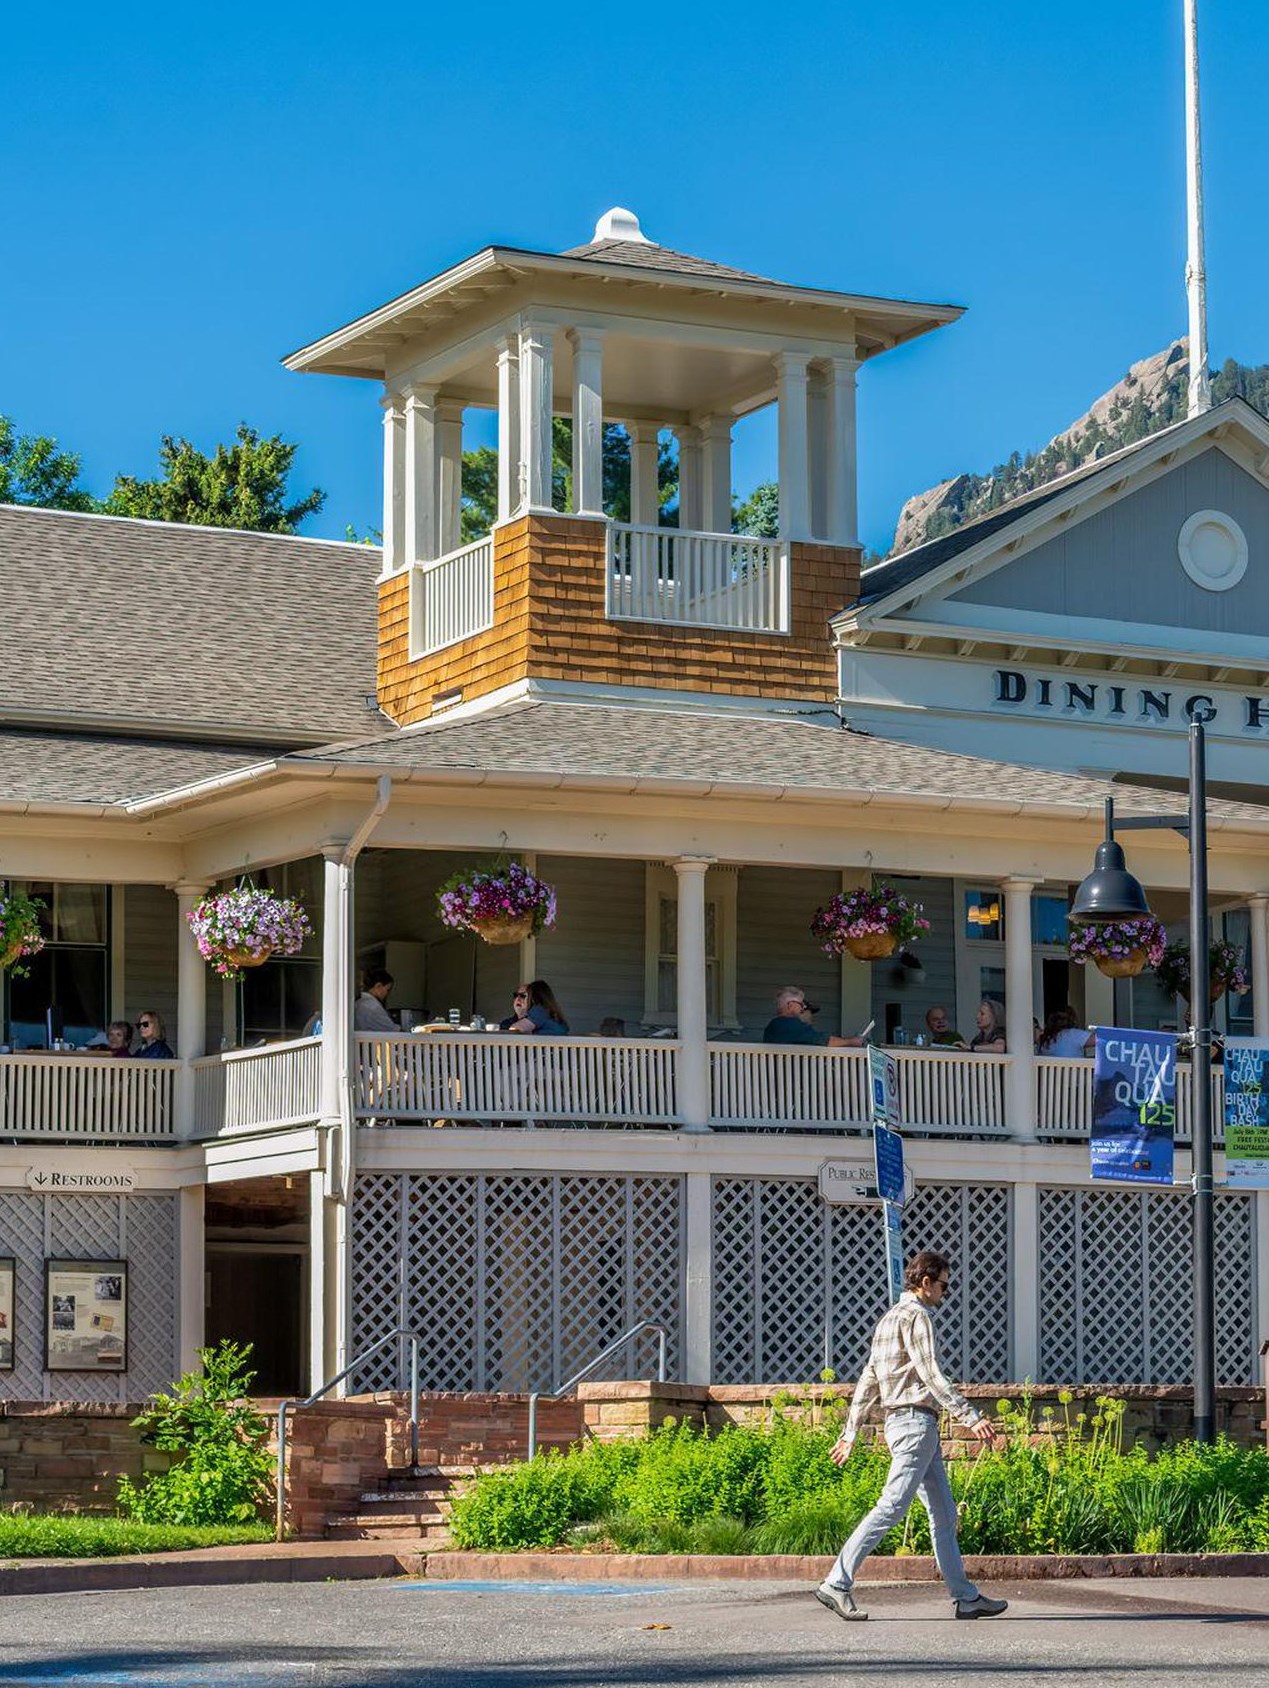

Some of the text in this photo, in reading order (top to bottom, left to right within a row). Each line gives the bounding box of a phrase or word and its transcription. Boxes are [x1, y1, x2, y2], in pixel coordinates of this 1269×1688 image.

[995, 670, 1218, 723] DINING
[1105, 1040, 1171, 1066] CHAU
[1225, 1048, 1260, 1061] CHAU
[1238, 1058, 1263, 1073] TAU
[1130, 1063, 1176, 1086] TAU
[1231, 1070, 1258, 1085] QUA
[1115, 1076, 1166, 1107] QUA
[1226, 1093, 1260, 1105] BIRTH
[1138, 1102, 1175, 1126] 125
[1238, 1103, 1260, 1116] DAY
[1230, 1114, 1260, 1127] BASH
[51, 1172, 133, 1187] RESTROOMS
[828, 1167, 857, 1179] PUBLIC
